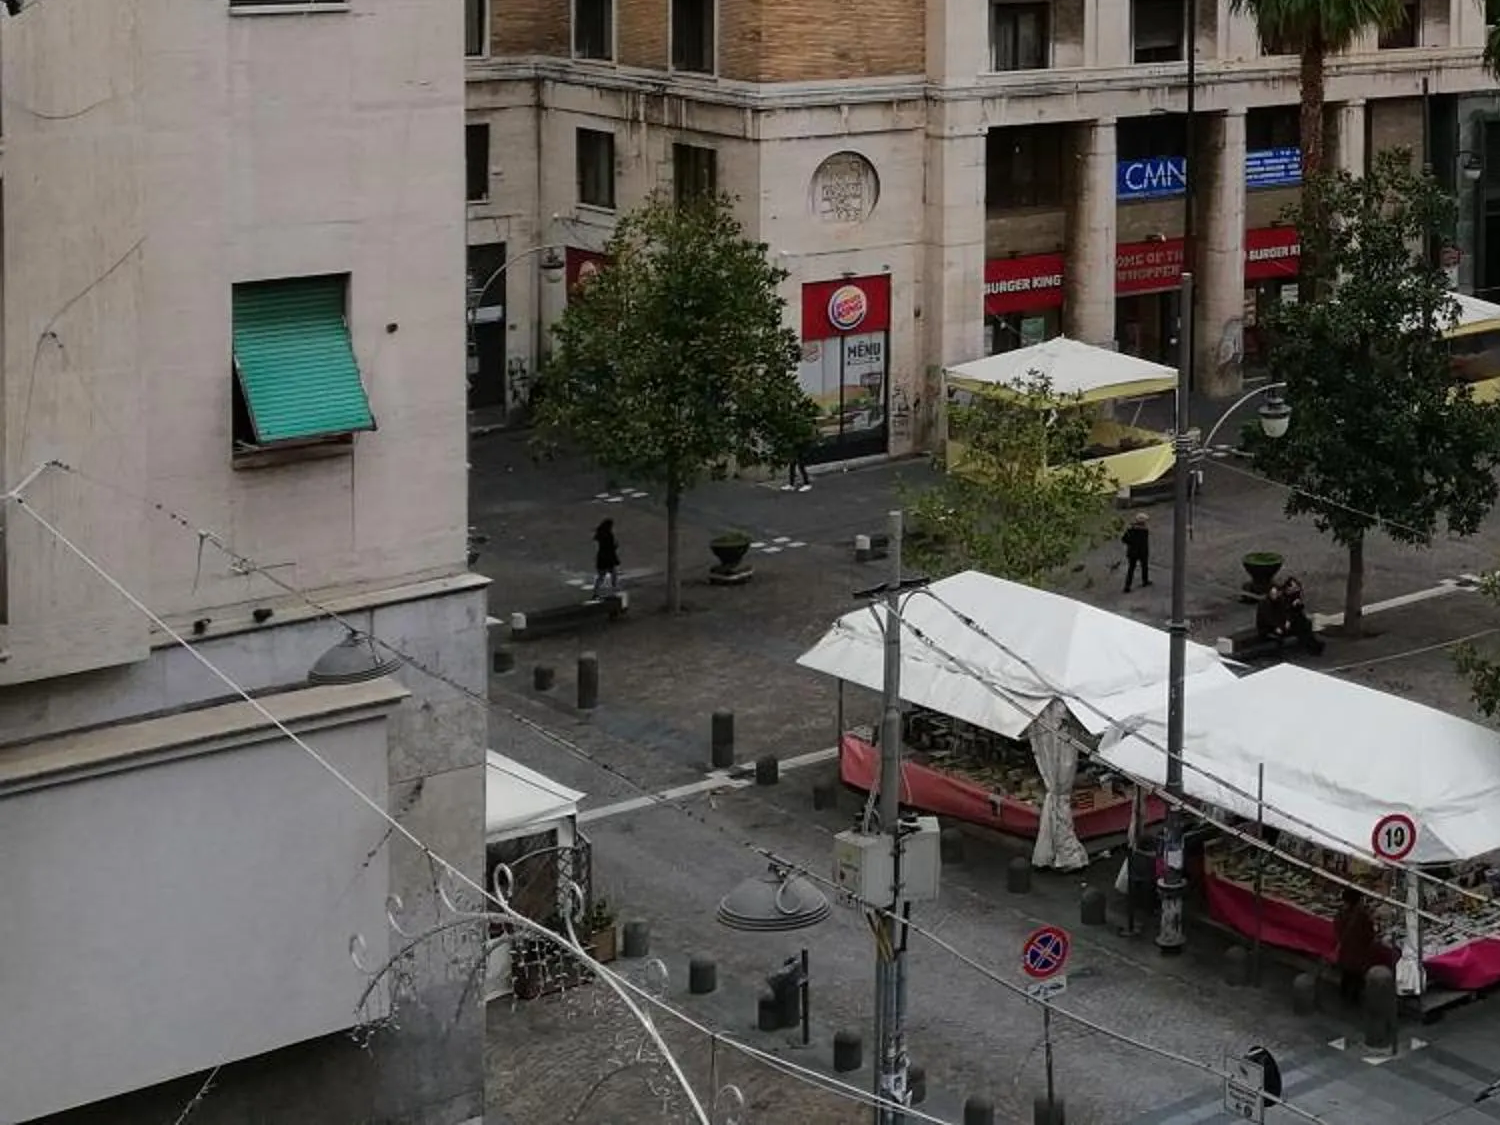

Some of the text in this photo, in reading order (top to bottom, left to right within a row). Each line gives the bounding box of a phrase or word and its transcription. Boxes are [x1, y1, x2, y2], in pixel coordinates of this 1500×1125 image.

[1126, 160, 1187, 189] CMN
[1249, 248, 1289, 261] BURGER
[1032, 274, 1063, 289] KING
[1386, 827, 1405, 848] 10
